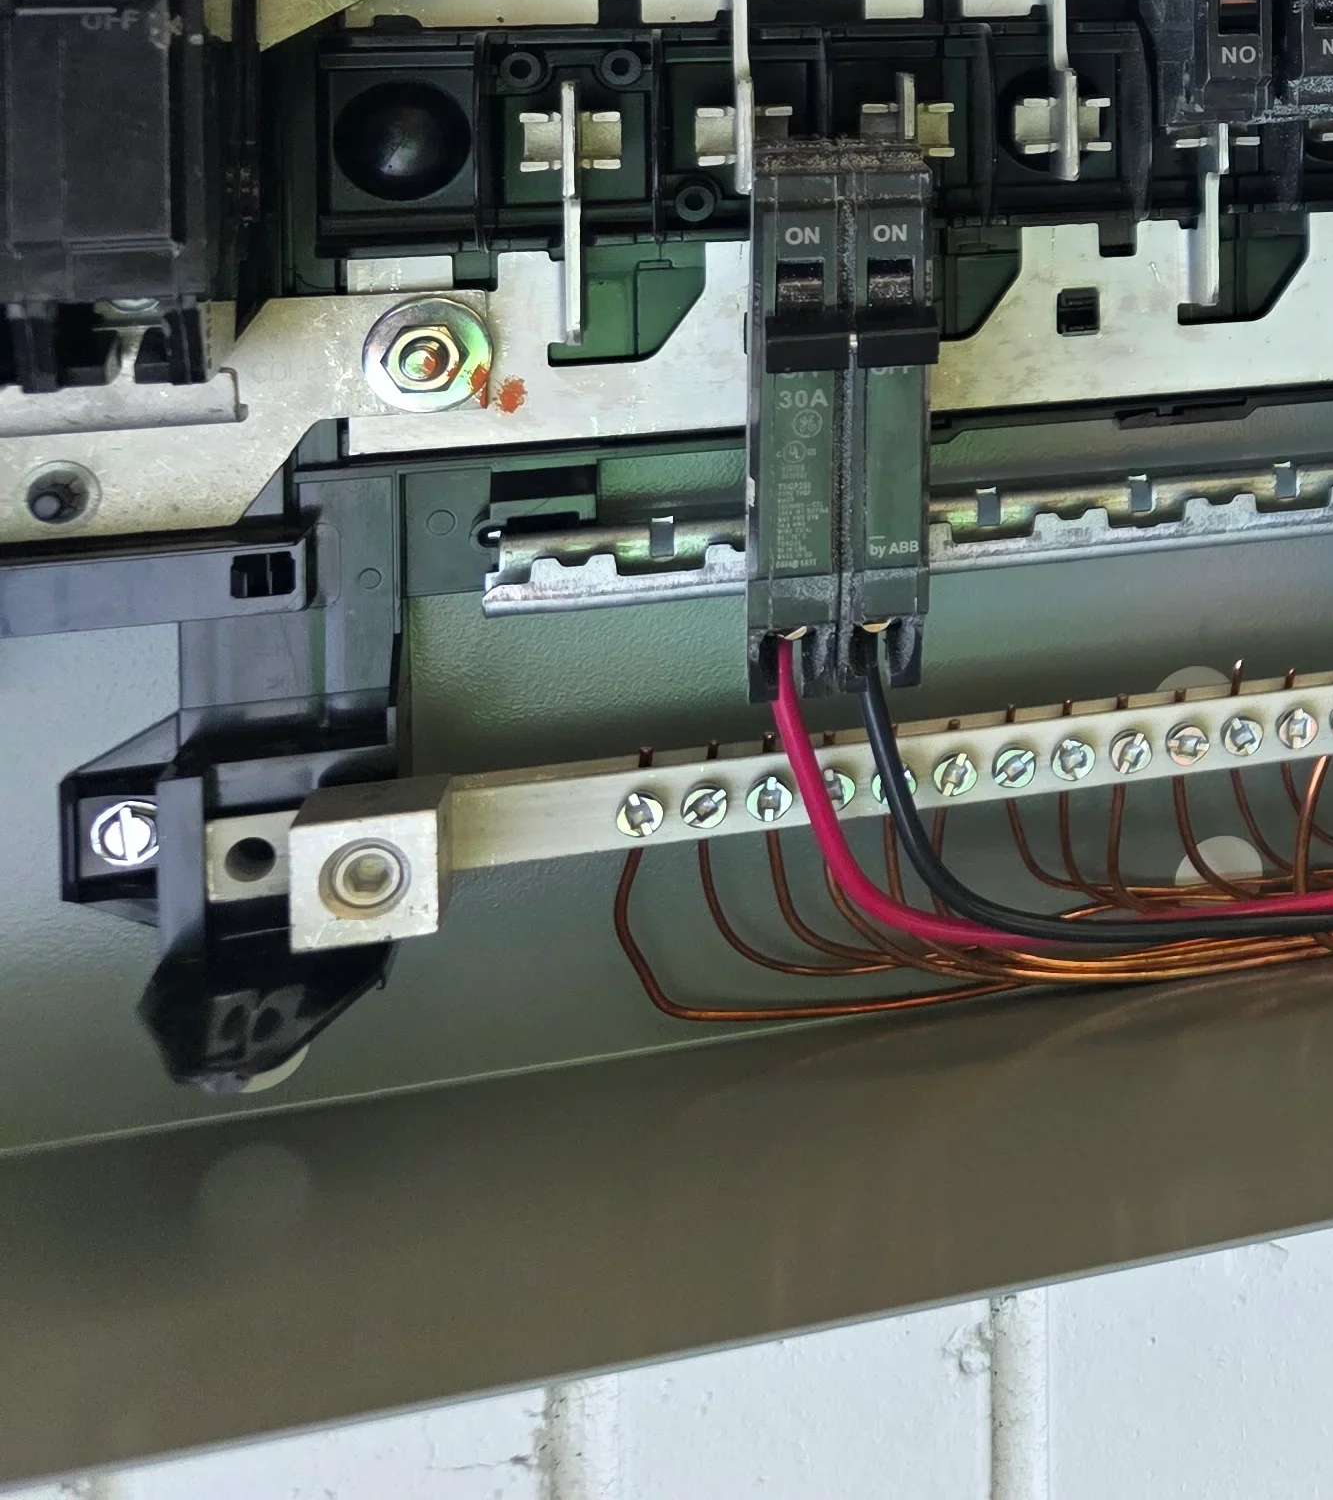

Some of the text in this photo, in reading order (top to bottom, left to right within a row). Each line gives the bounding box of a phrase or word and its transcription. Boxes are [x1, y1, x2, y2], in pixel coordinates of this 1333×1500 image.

[1221, 46, 1256, 63] ON
[785, 227, 820, 245] ON
[873, 224, 907, 242] ON
[779, 389, 828, 408] 30A
[870, 541, 919, 558] by ABB
